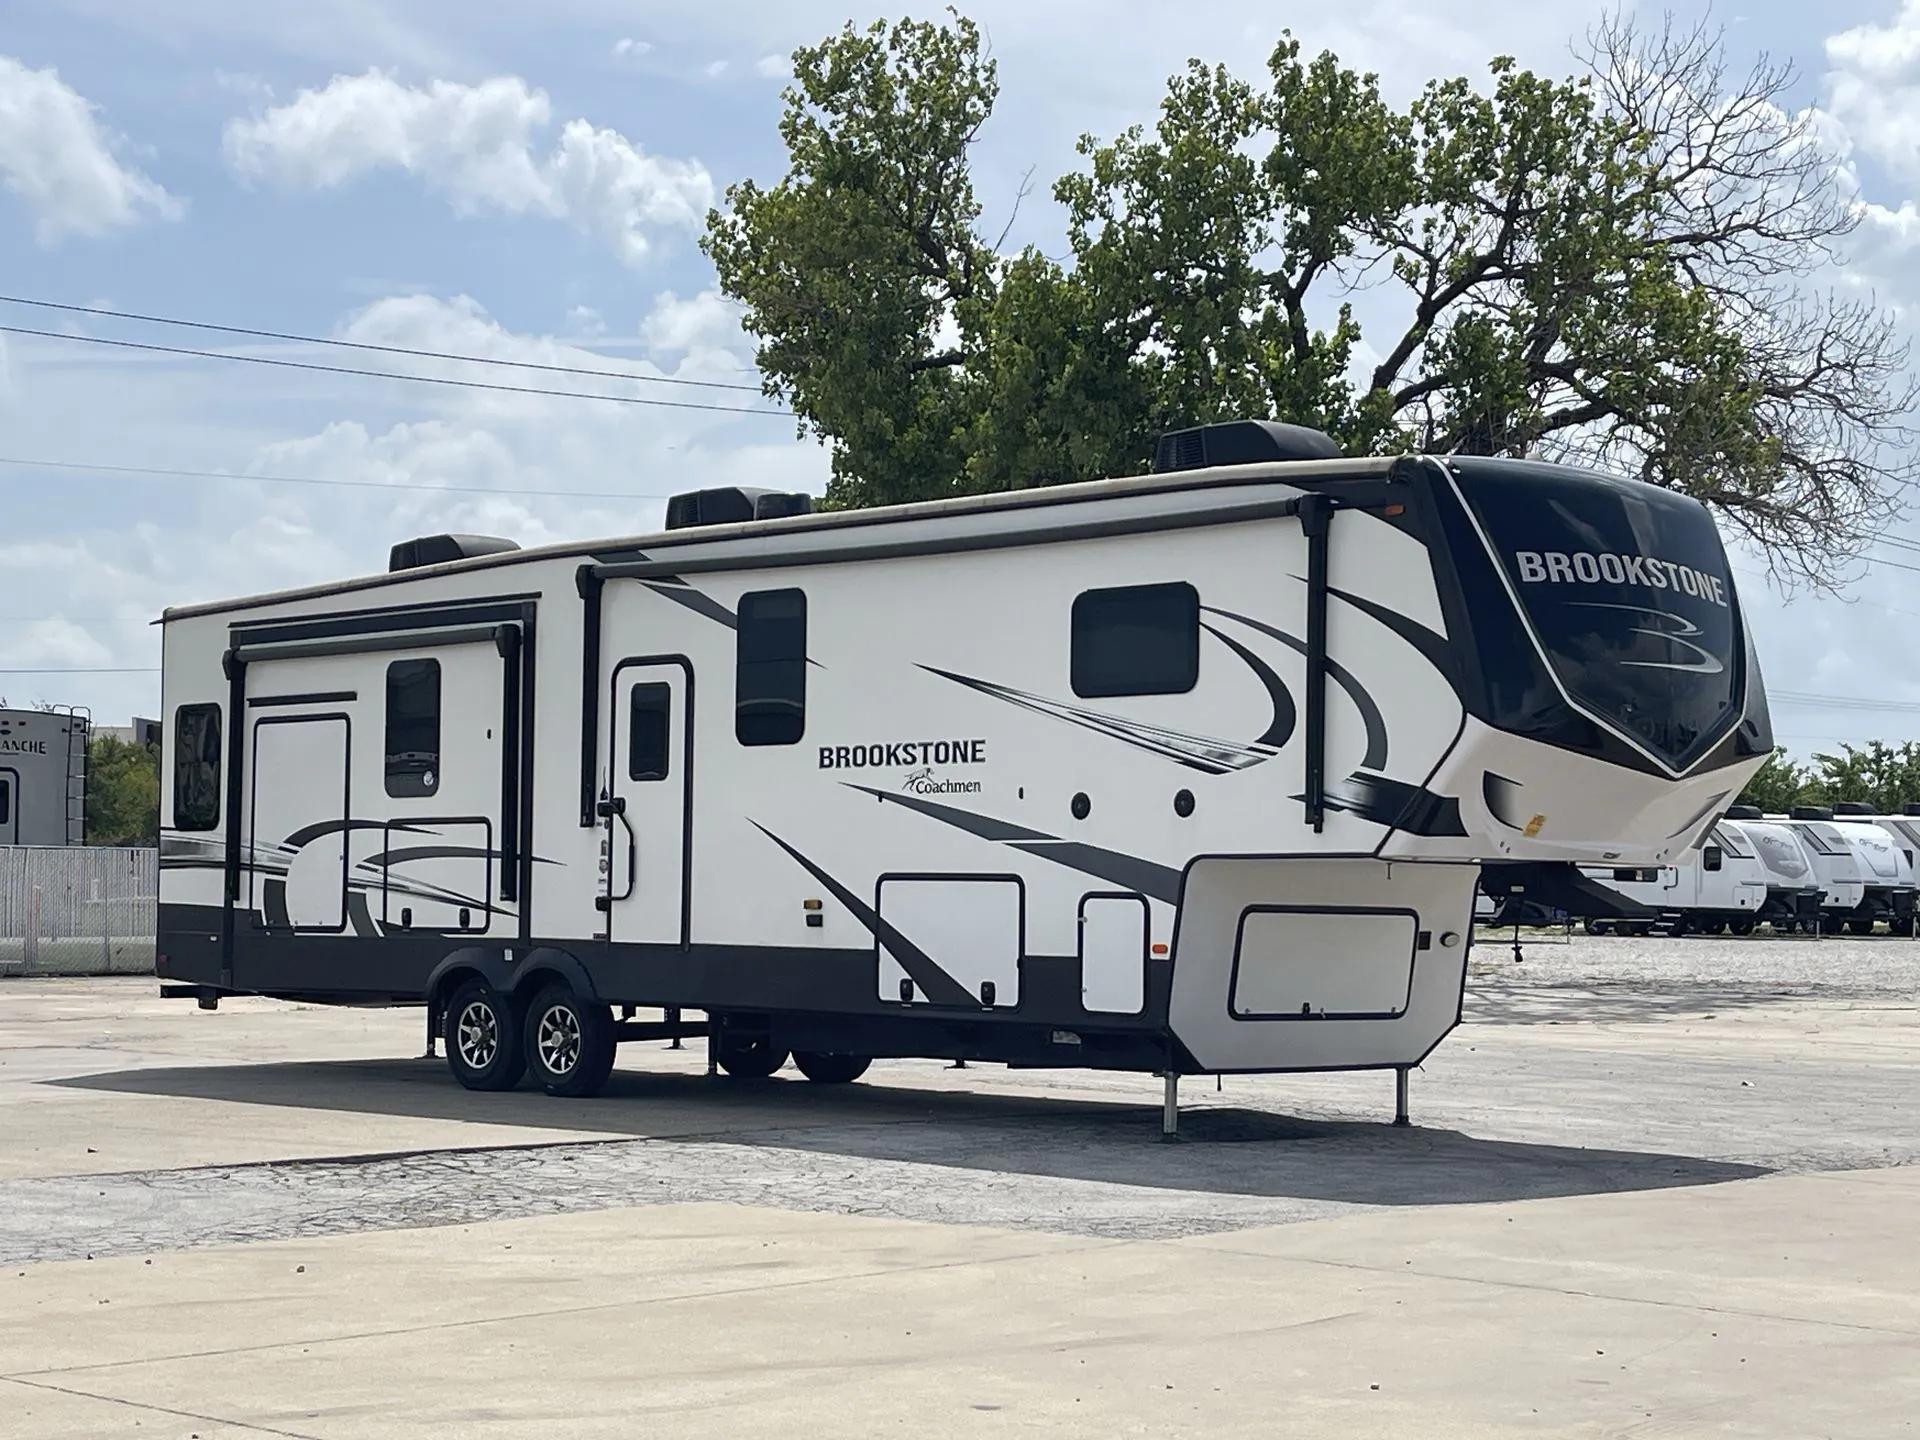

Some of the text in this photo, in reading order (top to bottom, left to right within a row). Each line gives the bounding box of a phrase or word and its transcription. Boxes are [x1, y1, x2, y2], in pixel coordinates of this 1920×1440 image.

[1516, 551, 1728, 608] BROOKSTONE
[819, 739, 987, 769] BROOKSTONE
[915, 779, 982, 794] Coachmen
